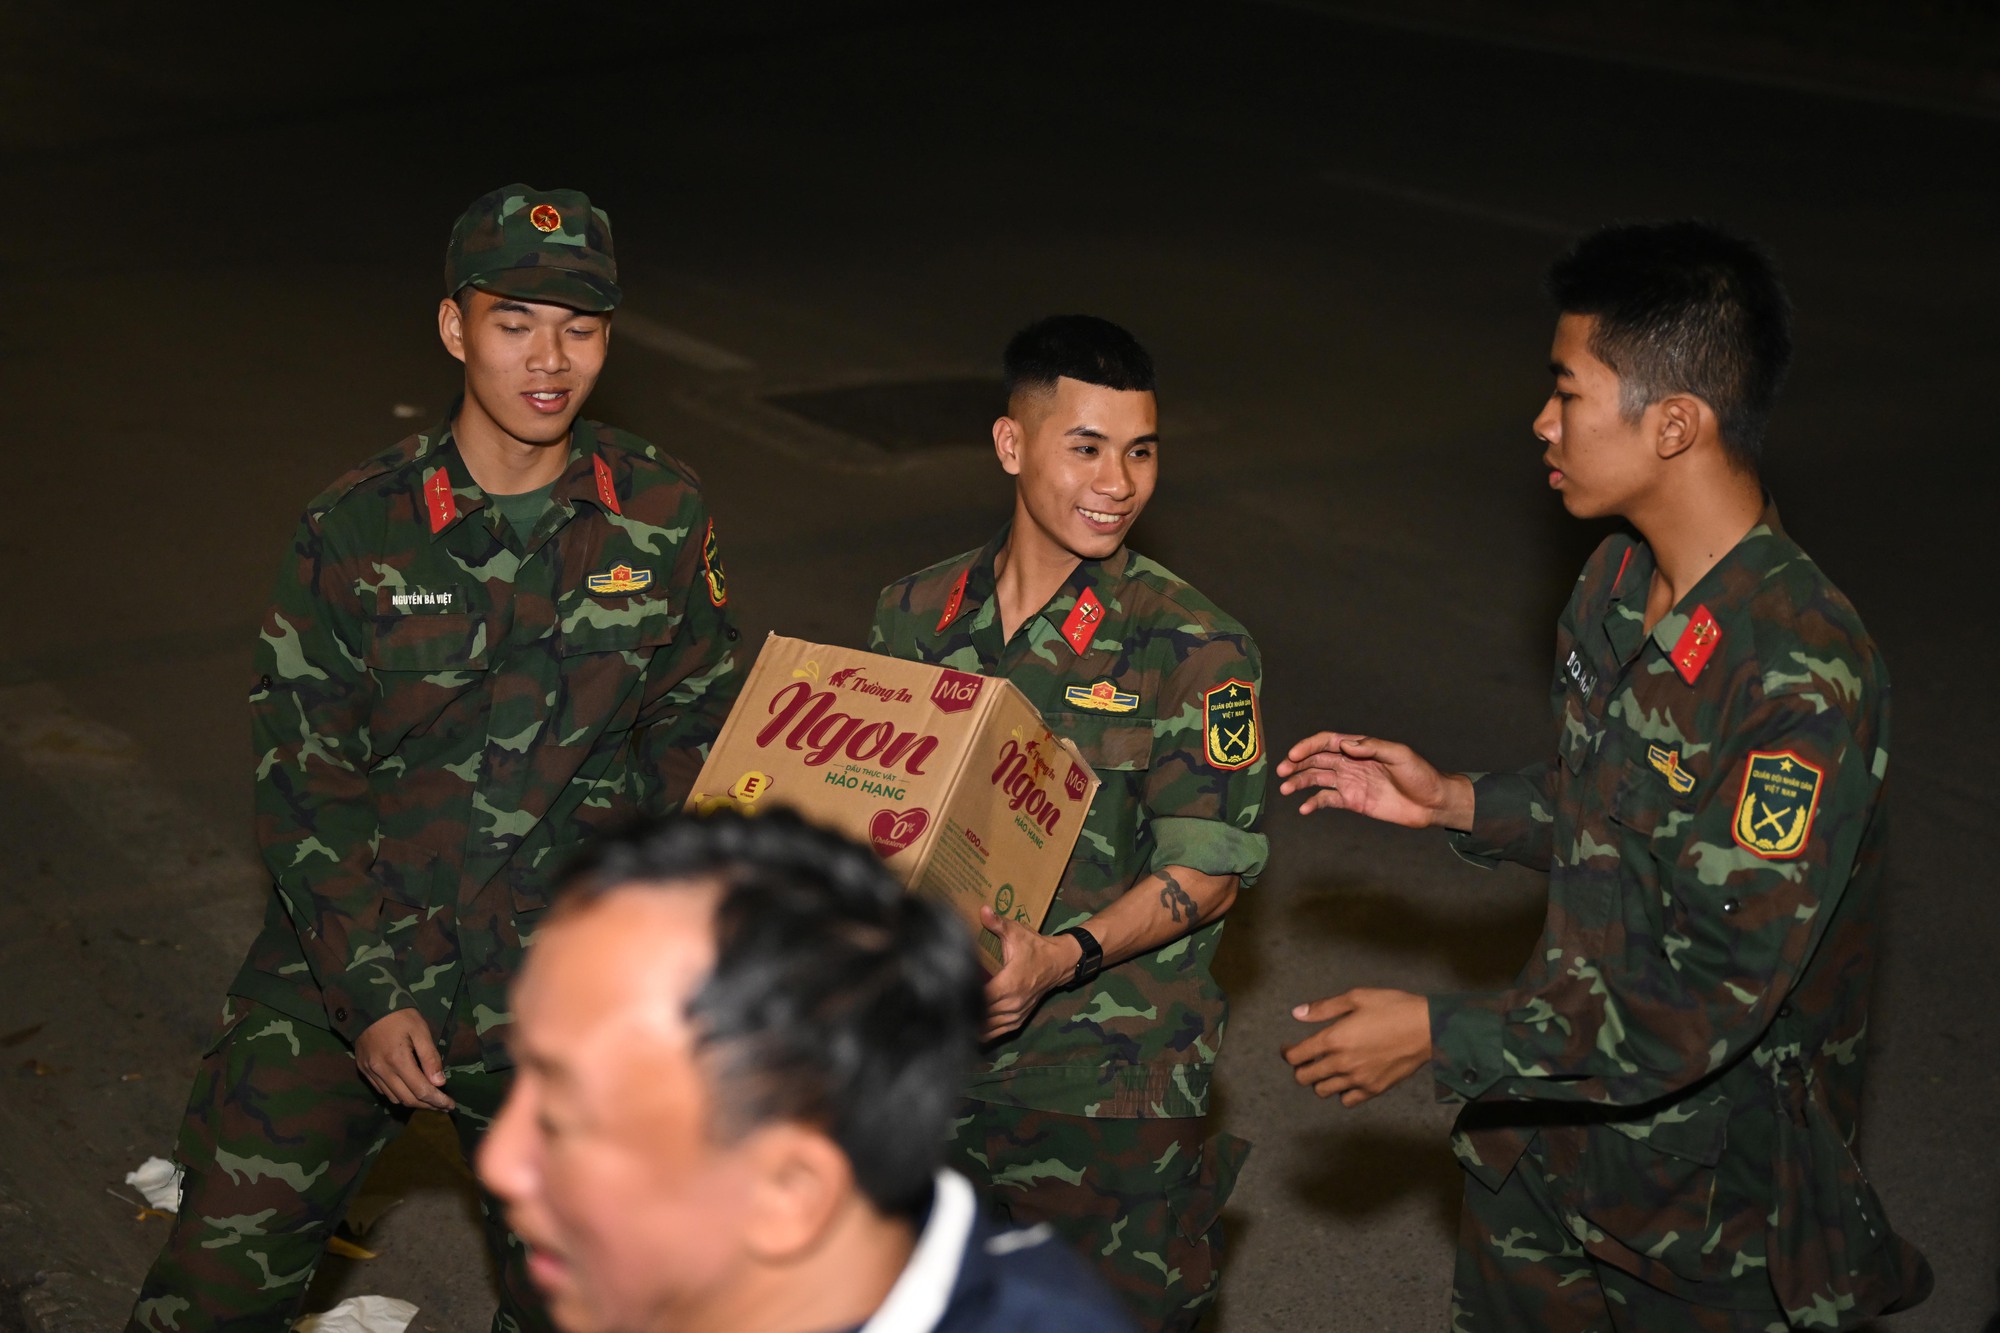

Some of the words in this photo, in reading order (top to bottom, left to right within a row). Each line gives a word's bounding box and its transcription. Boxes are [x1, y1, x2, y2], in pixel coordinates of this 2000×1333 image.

[424, 592, 435, 605] BÁ
[436, 592, 452, 606] VIỆT
[895, 688, 913, 703] An
[935, 680, 979, 701] Mới
[756, 681, 939, 775] Ngon
[744, 777, 760, 793] E
[824, 770, 859, 789] HẢO
[860, 780, 906, 801] HẠNG
[992, 739, 1061, 836] Ngon
[1066, 769, 1087, 793] Mới
[890, 821, 916, 840] 0%
[965, 828, 980, 847] KIDO
